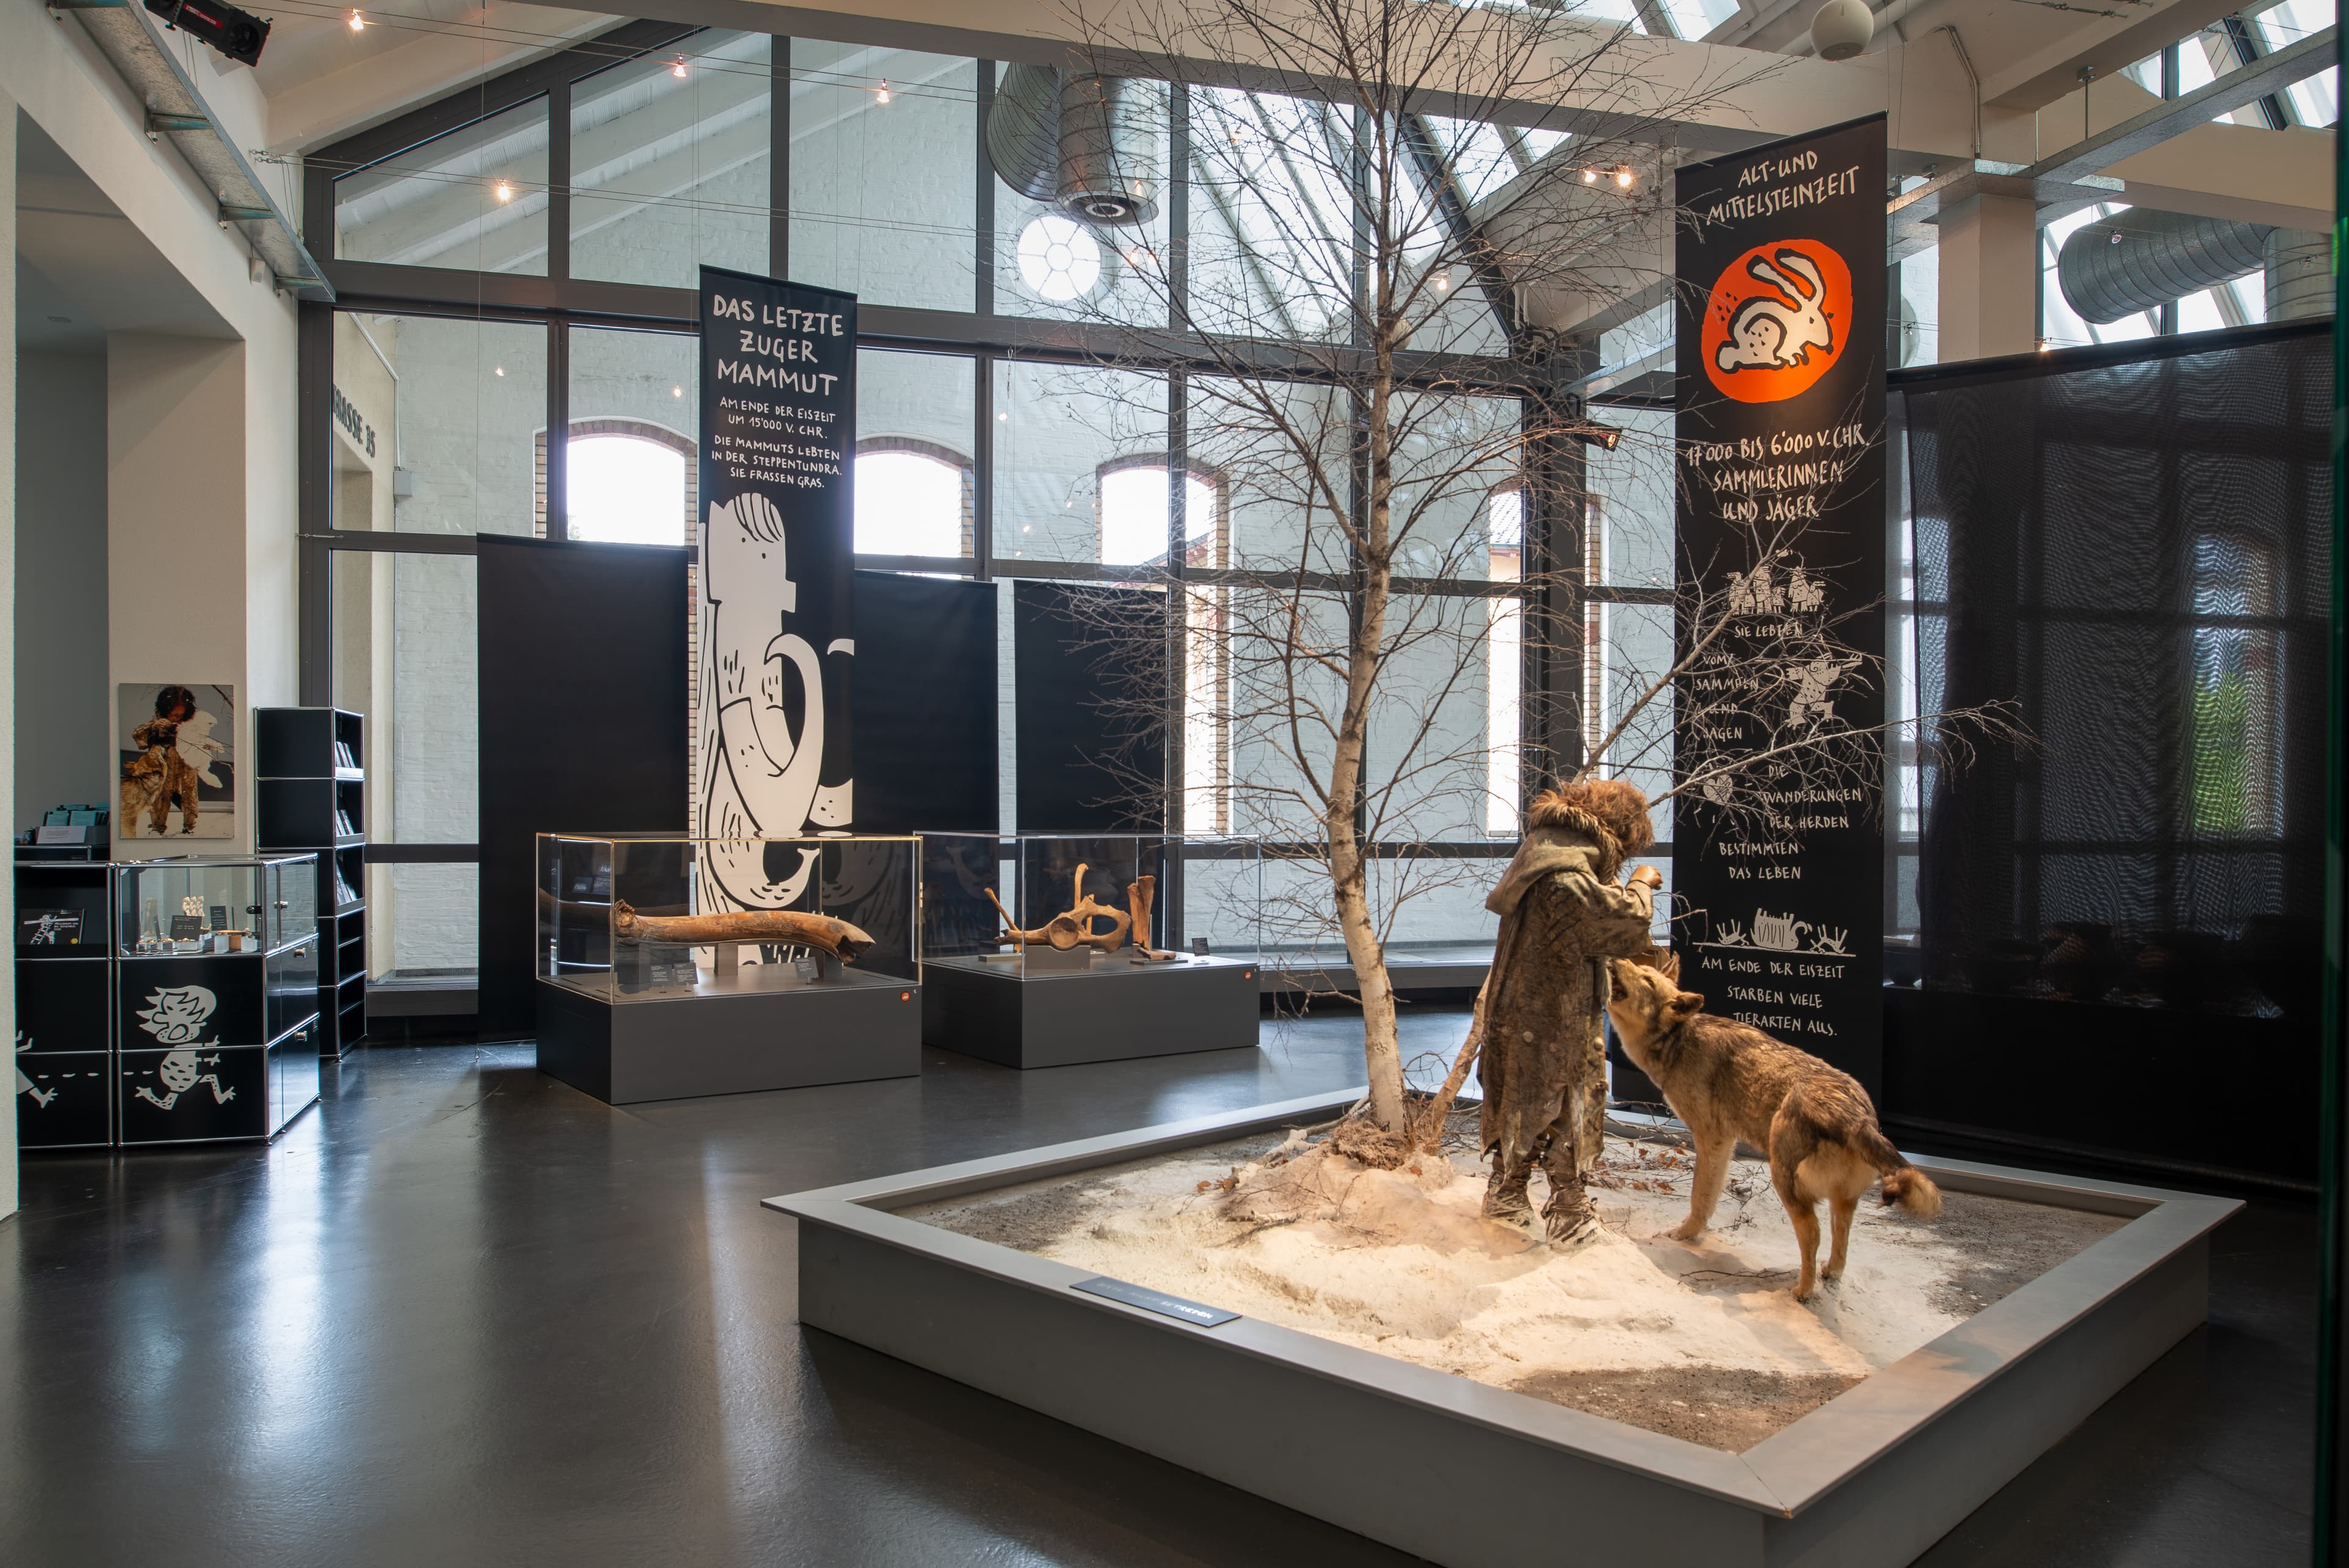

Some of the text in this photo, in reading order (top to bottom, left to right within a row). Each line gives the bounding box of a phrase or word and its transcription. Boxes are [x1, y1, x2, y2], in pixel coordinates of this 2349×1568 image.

[1706, 165, 1860, 226] MITTELSTEINZEIT
[713, 294, 844, 336] DAS LETZTE
[740, 329, 818, 363] ZUGER
[718, 359, 838, 396] MAMMUT
[720, 396, 836, 423] AM ENDE DER EISZEIT
[728, 414, 828, 439] UM 15'000 V. CHR.
[714, 434, 840, 461] DIE MAMMUTS LEBTEN
[1740, 436, 1764, 461] BIS
[1771, 431, 1813, 455] 6'000
[711, 450, 842, 476] IN DER STEPPENTUNDRA.
[730, 467, 825, 488] SIE FRASSEN GRAS.
[1713, 460, 1843, 493] SAMMLERINNEN
[1723, 494, 1819, 522] UND JÄGER
[1735, 622, 1803, 638] SIE LEBTEN
[1703, 655, 1727, 665] VOM
[1768, 765, 1789, 778] DIE
[1764, 787, 1862, 803] WANDERUNGEN
[1770, 816, 1849, 830] DER HERDEN
[1719, 842, 1799, 856] BESTIMMTEN
[1729, 866, 1801, 880] DAS LEBEN
[1702, 956, 1845, 979] AM ENDE DER EISZEIT
[1727, 986, 1823, 1009] STARBEN VIELE
[1733, 1013, 1838, 1036] TIERARTEN AUS.
